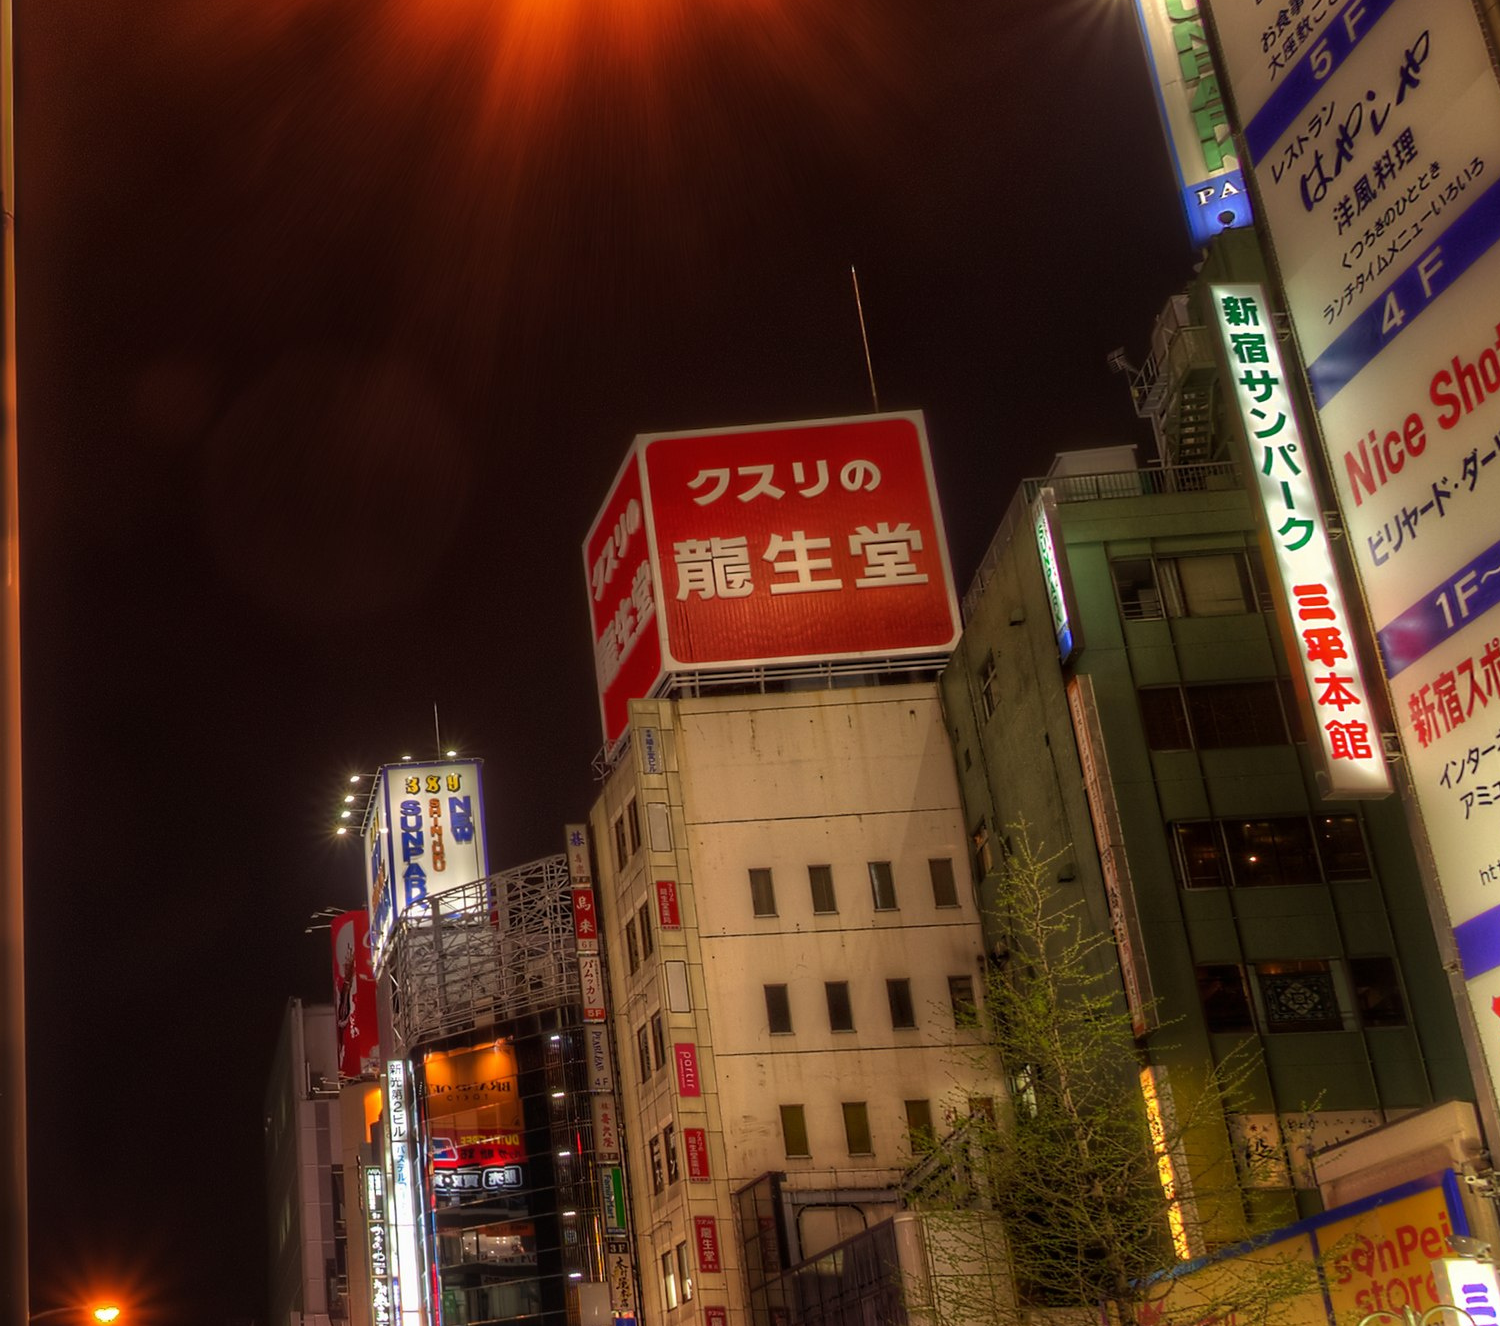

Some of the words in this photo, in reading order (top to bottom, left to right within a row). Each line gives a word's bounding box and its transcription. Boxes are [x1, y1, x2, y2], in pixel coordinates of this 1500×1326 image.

[1269, 99, 1338, 186] レストラン
[1330, 131, 1420, 238] 洋風料理
[1321, 155, 1486, 327] ランチタイムメニューいろいろ
[1340, 161, 1444, 271] くつろぎのひととき
[1220, 294, 1319, 555] 新宿サンパーク
[1342, 419, 1428, 509] Nice
[687, 458, 883, 507] クスリの
[672, 522, 930, 602] 龍生堂
[1290, 581, 1373, 763] 三平本館
[448, 795, 475, 843] NEW
[609, 1244, 626, 1253] 3F
